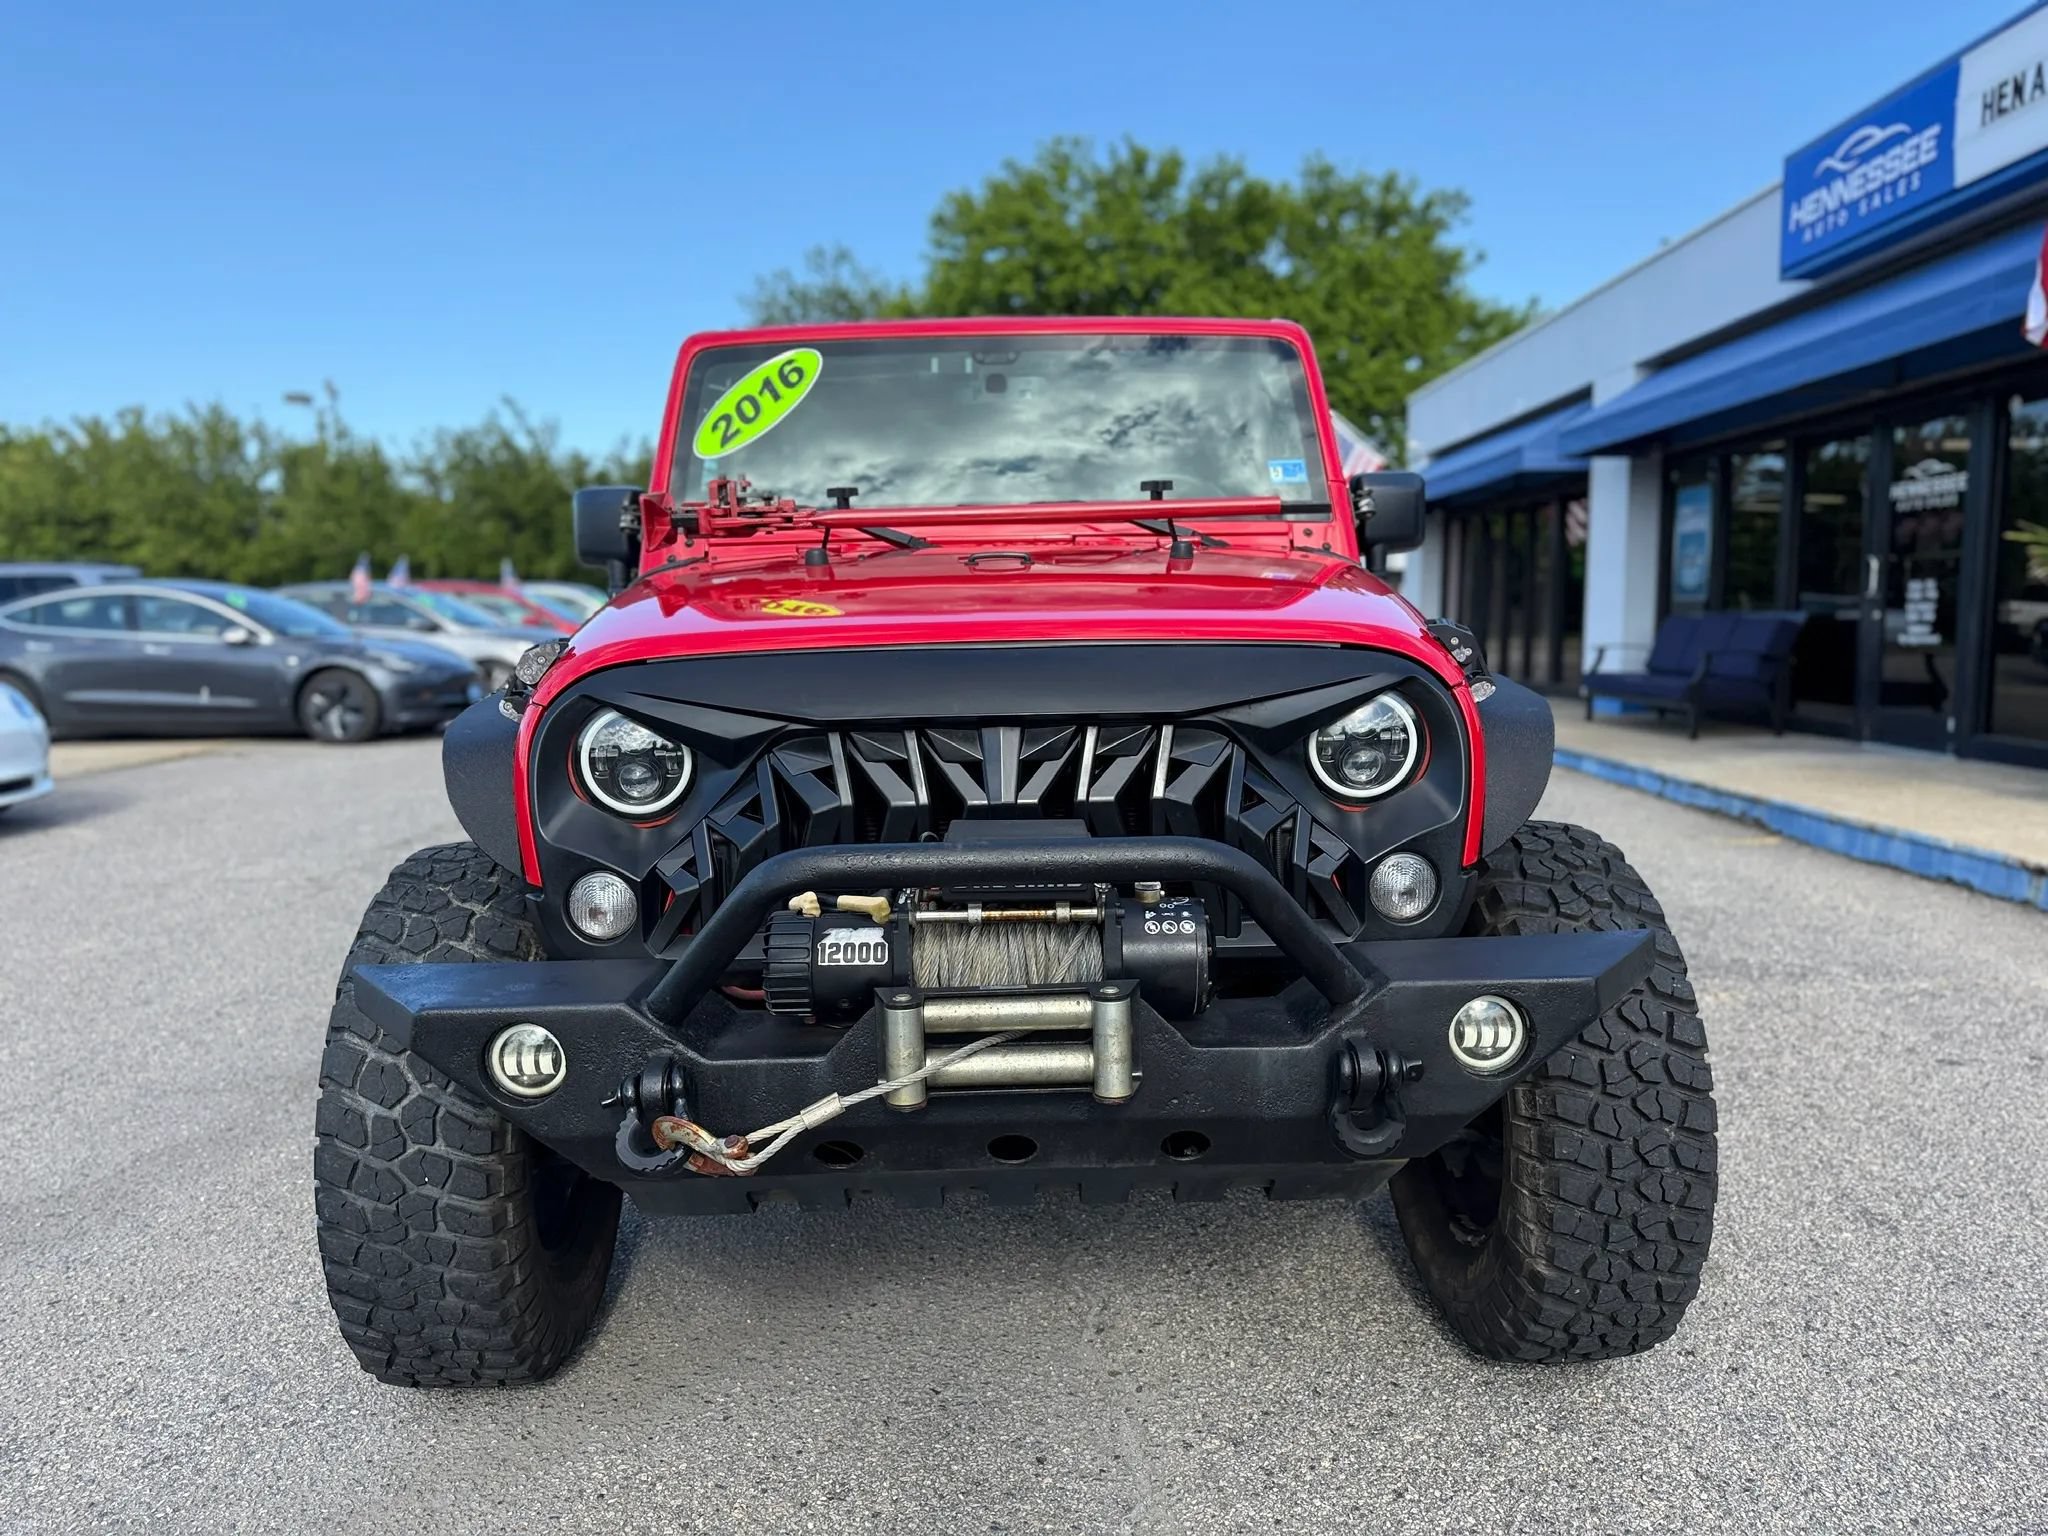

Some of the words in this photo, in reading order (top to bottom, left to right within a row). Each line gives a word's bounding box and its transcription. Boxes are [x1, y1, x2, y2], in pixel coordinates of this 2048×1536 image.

[1788, 122, 1943, 234] HENNESSEE
[1802, 208, 1849, 243] AUTO
[1858, 170, 1922, 217] SALES
[711, 358, 805, 448] 2016
[818, 941, 887, 963] 12000
